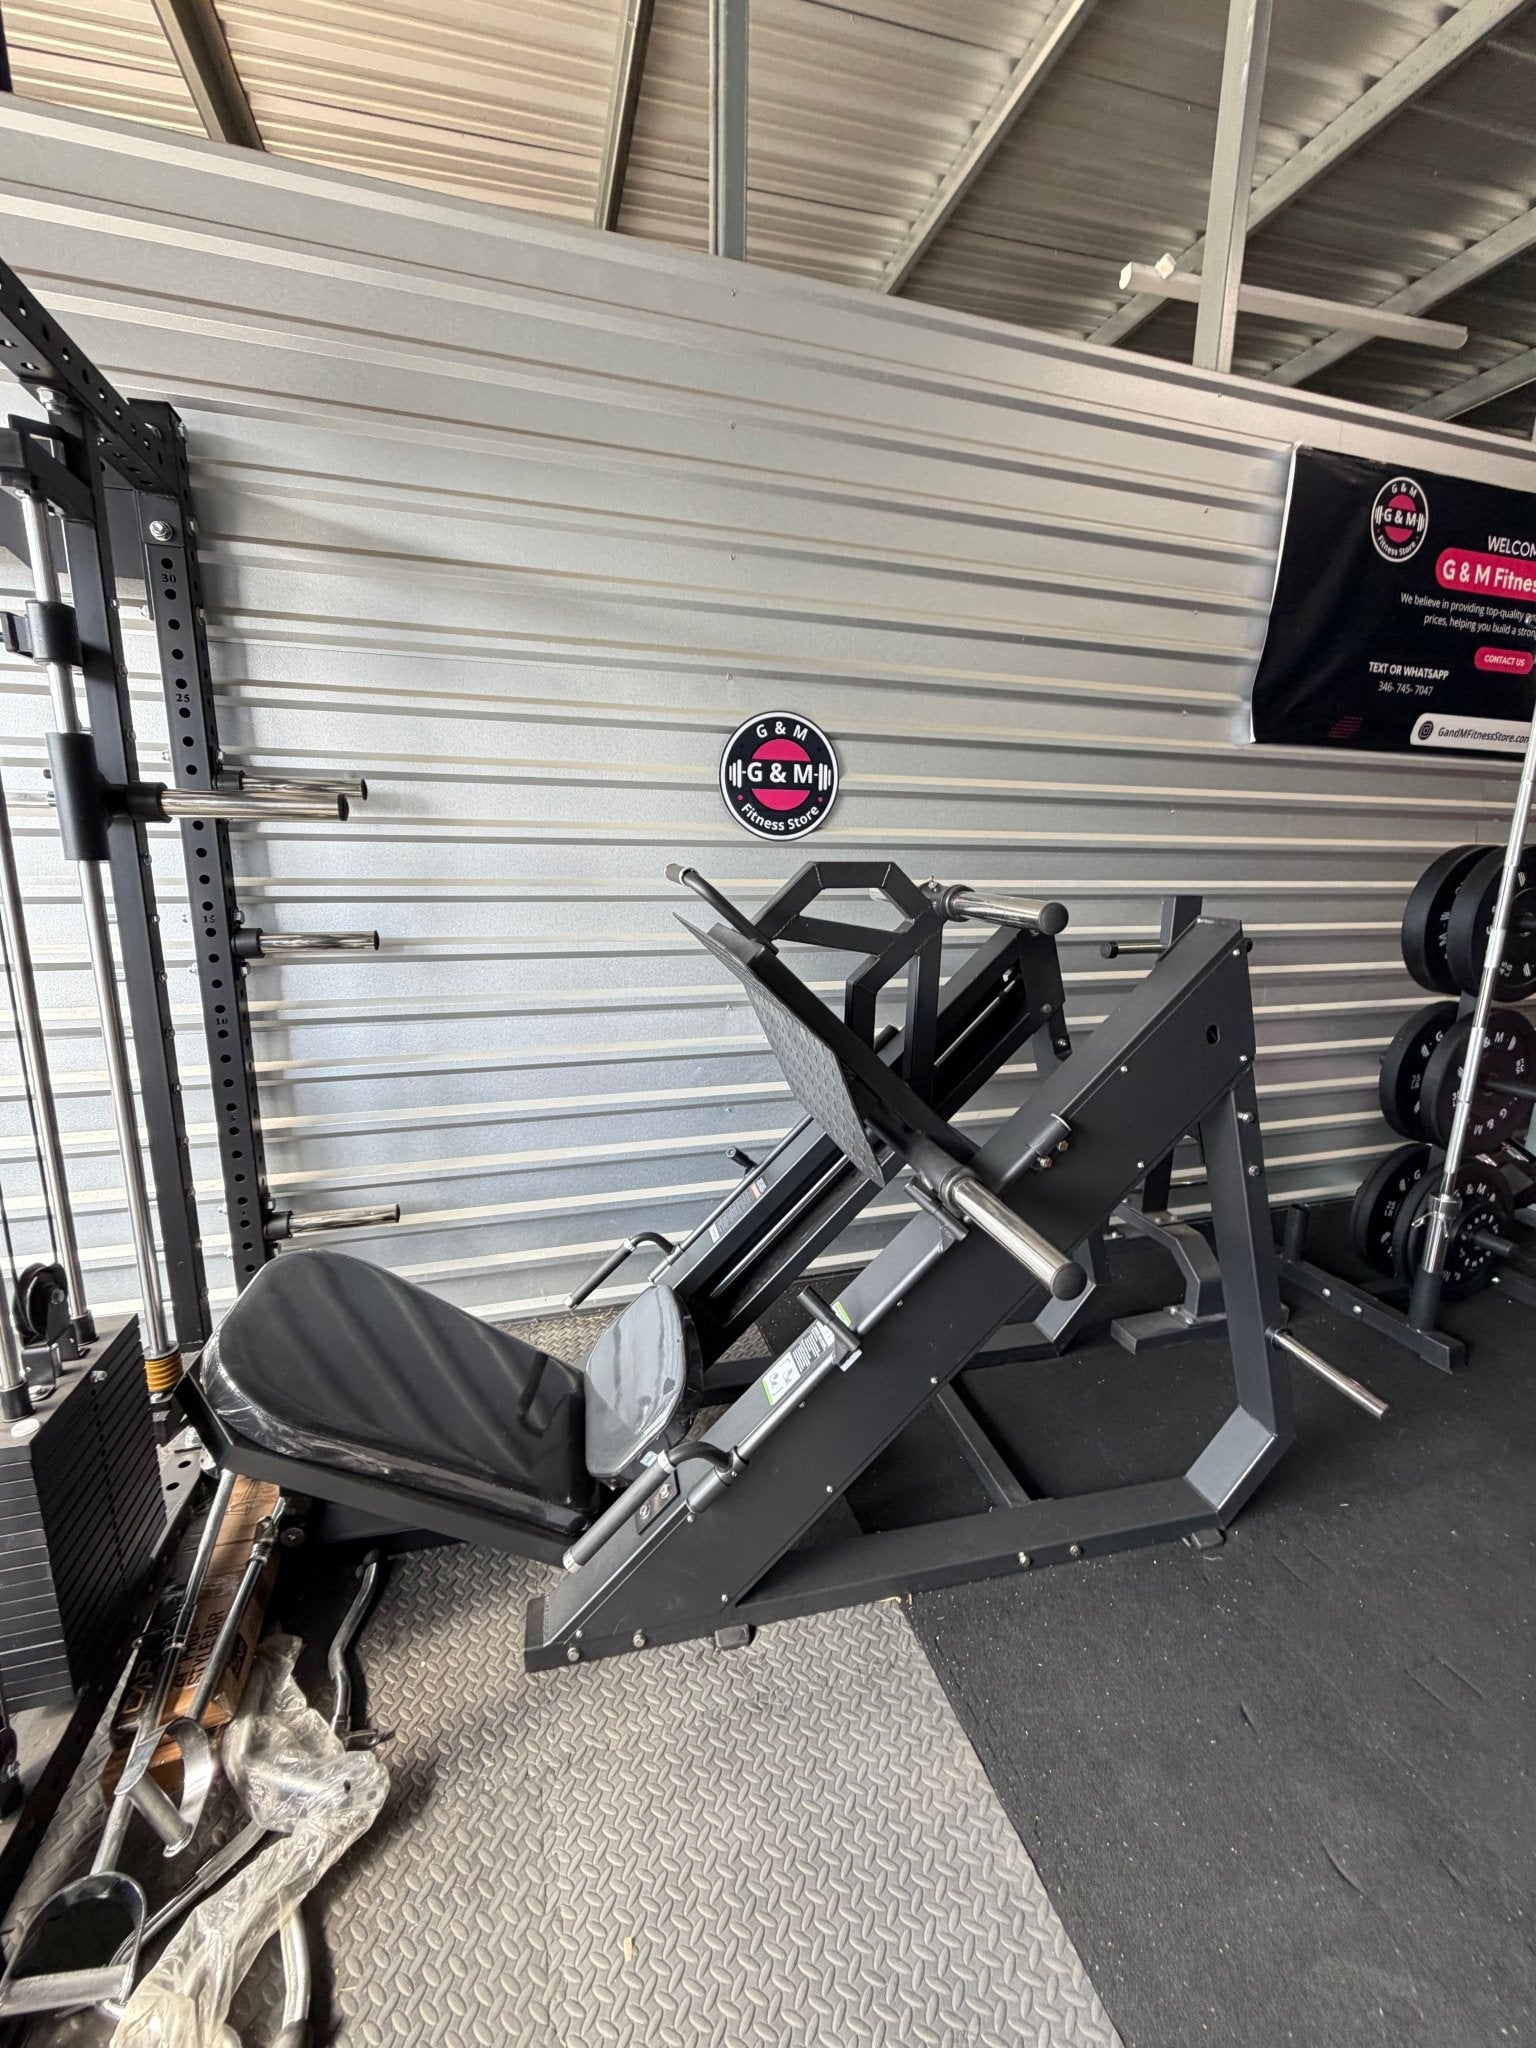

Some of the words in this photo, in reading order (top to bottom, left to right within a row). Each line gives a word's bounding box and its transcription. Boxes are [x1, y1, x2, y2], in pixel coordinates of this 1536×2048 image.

[1391, 483, 1398, 494] G
[1400, 483, 1408, 493] &
[1408, 486, 1417, 498] M
[1384, 507, 1393, 522] G
[1394, 509, 1403, 524] &
[1405, 511, 1417, 527] M
[1377, 534, 1398, 556] Fitness
[1399, 540, 1416, 556] Store
[161, 573, 177, 583] 30
[1442, 559, 1456, 581] G
[1459, 561, 1470, 583] &
[1474, 563, 1491, 586] M
[1400, 592, 1413, 604] We
[1414, 594, 1441, 609] believe
[1442, 598, 1450, 610] in
[1450, 601, 1485, 617] providing
[1486, 605, 1524, 622] top-quality
[1423, 614, 1448, 627] prices,
[1449, 616, 1476, 632] helping
[1477, 622, 1491, 633] you
[1491, 622, 1511, 635] build
[1511, 626, 1517, 635] a
[1517, 626, 1536, 639] stron
[1484, 654, 1516, 666] CONTACT
[1516, 657, 1525, 667] US
[1369, 661, 1389, 674] TEXT
[1389, 664, 1402, 676] OR
[1403, 666, 1449, 681] WHATSAPP
[175, 693, 191, 703] 25
[1415, 684, 1433, 696] 7047
[756, 723, 768, 738] G
[774, 720, 786, 735] &
[792, 724, 809, 741] M
[747, 761, 763, 783] G
[769, 762, 787, 783] &
[793, 763, 813, 784] M
[740, 802, 785, 831] Fitness
[787, 805, 820, 830] Store
[203, 914, 216, 923] 15
[216, 1018, 228, 1026] 10
[204, 1610, 225, 1637] BAR
